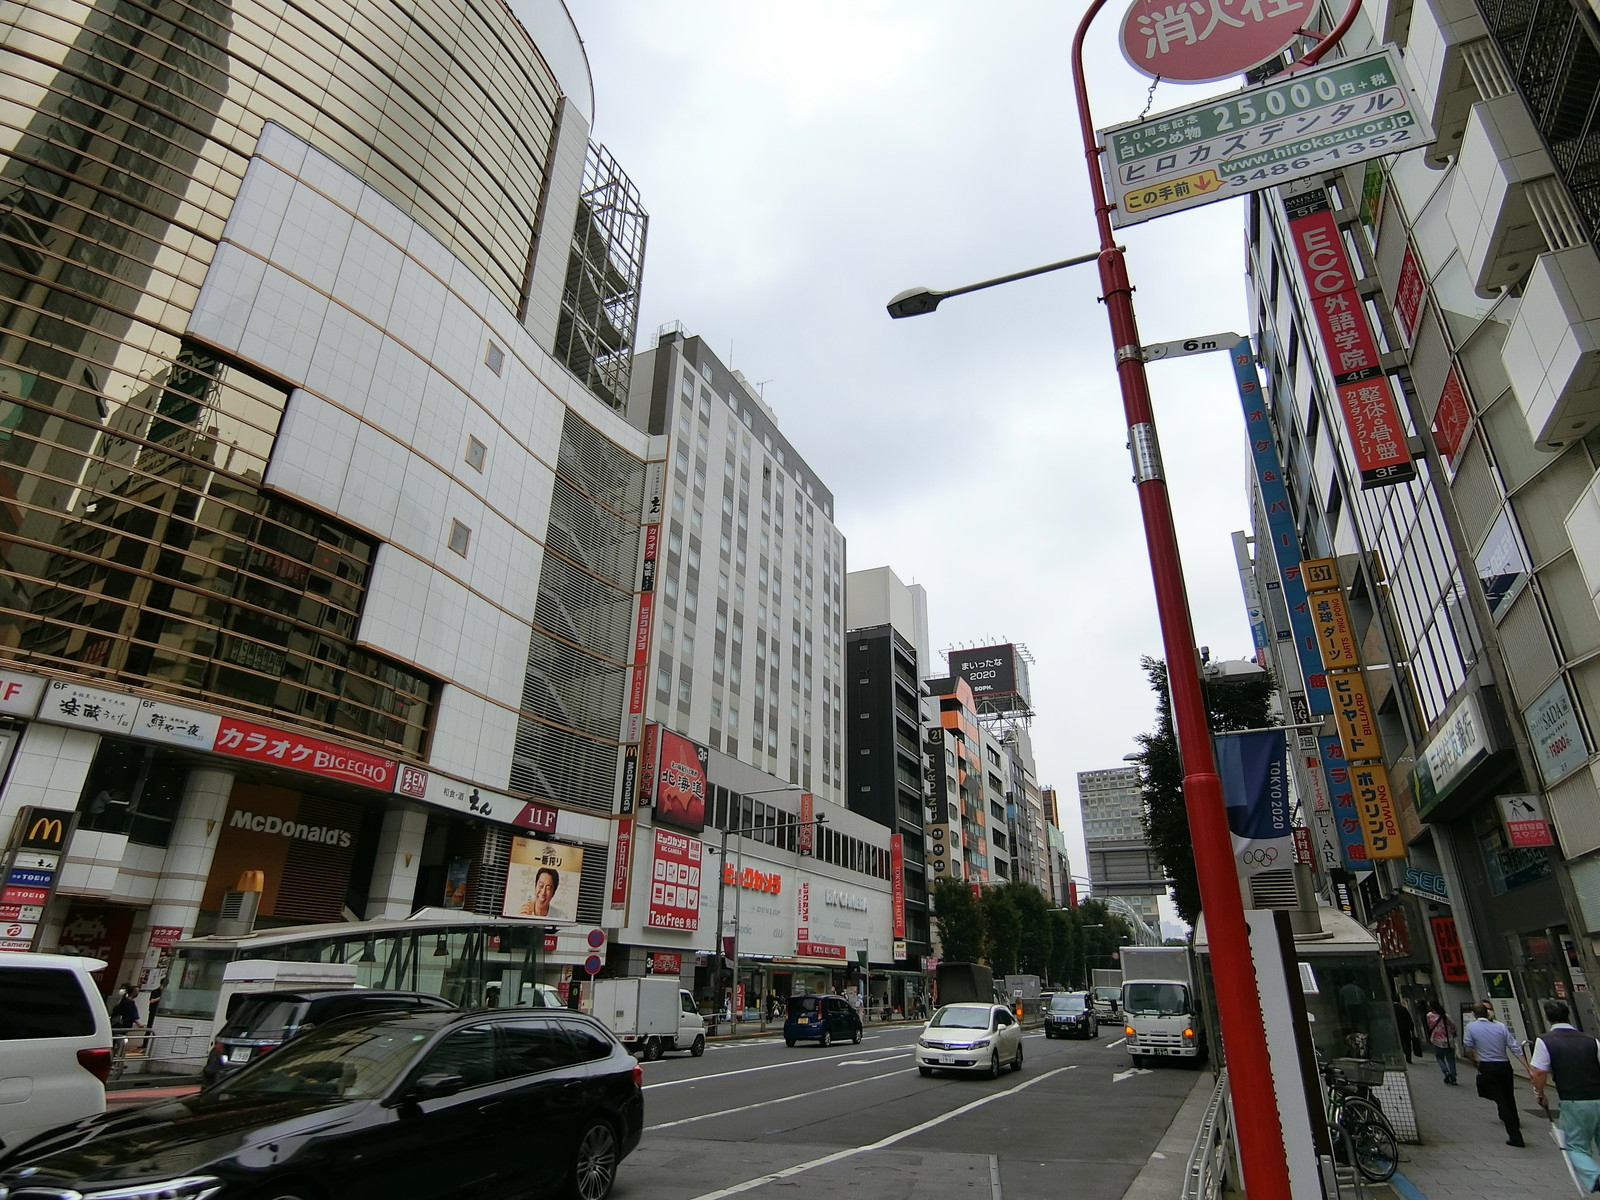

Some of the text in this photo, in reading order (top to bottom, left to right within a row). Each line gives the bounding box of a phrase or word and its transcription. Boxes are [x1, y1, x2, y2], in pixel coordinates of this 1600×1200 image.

[1119, 115, 1200, 145] 20周年記念
[1119, 127, 1202, 160] 白いつめ物
[1124, 93, 1396, 184] ヒロカズデンタル
[1221, 113, 1411, 174] www.hirokazu.or.jp
[1229, 130, 1413, 187] 3486-1352
[1128, 181, 1191, 209] この手前
[1298, 204, 1319, 217] 5F
[1346, 369, 1370, 381] 4F
[1375, 466, 1399, 478] 3F
[646, 527, 657, 558] カラオケ
[962, 657, 1003, 671] まいったな
[970, 670, 996, 680] 2020
[53, 681, 69, 691] 6F
[142, 700, 156, 709] 6F
[1335, 680, 1365, 752] ビリヤード
[1355, 692, 1372, 736] BILLIARD
[218, 727, 314, 762] カラオケ
[931, 730, 942, 740] 21
[385, 760, 395, 768] 6F
[698, 747, 708, 762] 3F
[413, 773, 425, 787] EN
[623, 761, 634, 813] McDonald's
[662, 769, 704, 799] 北海道
[1270, 760, 1284, 829] TOKYO 2020
[1357, 772, 1388, 850] ボウリング
[1377, 785, 1397, 836] BOWLING
[230, 809, 352, 848] McDonald's
[1404, 868, 1448, 895] SEG
[651, 910, 684, 928] TaxFree
